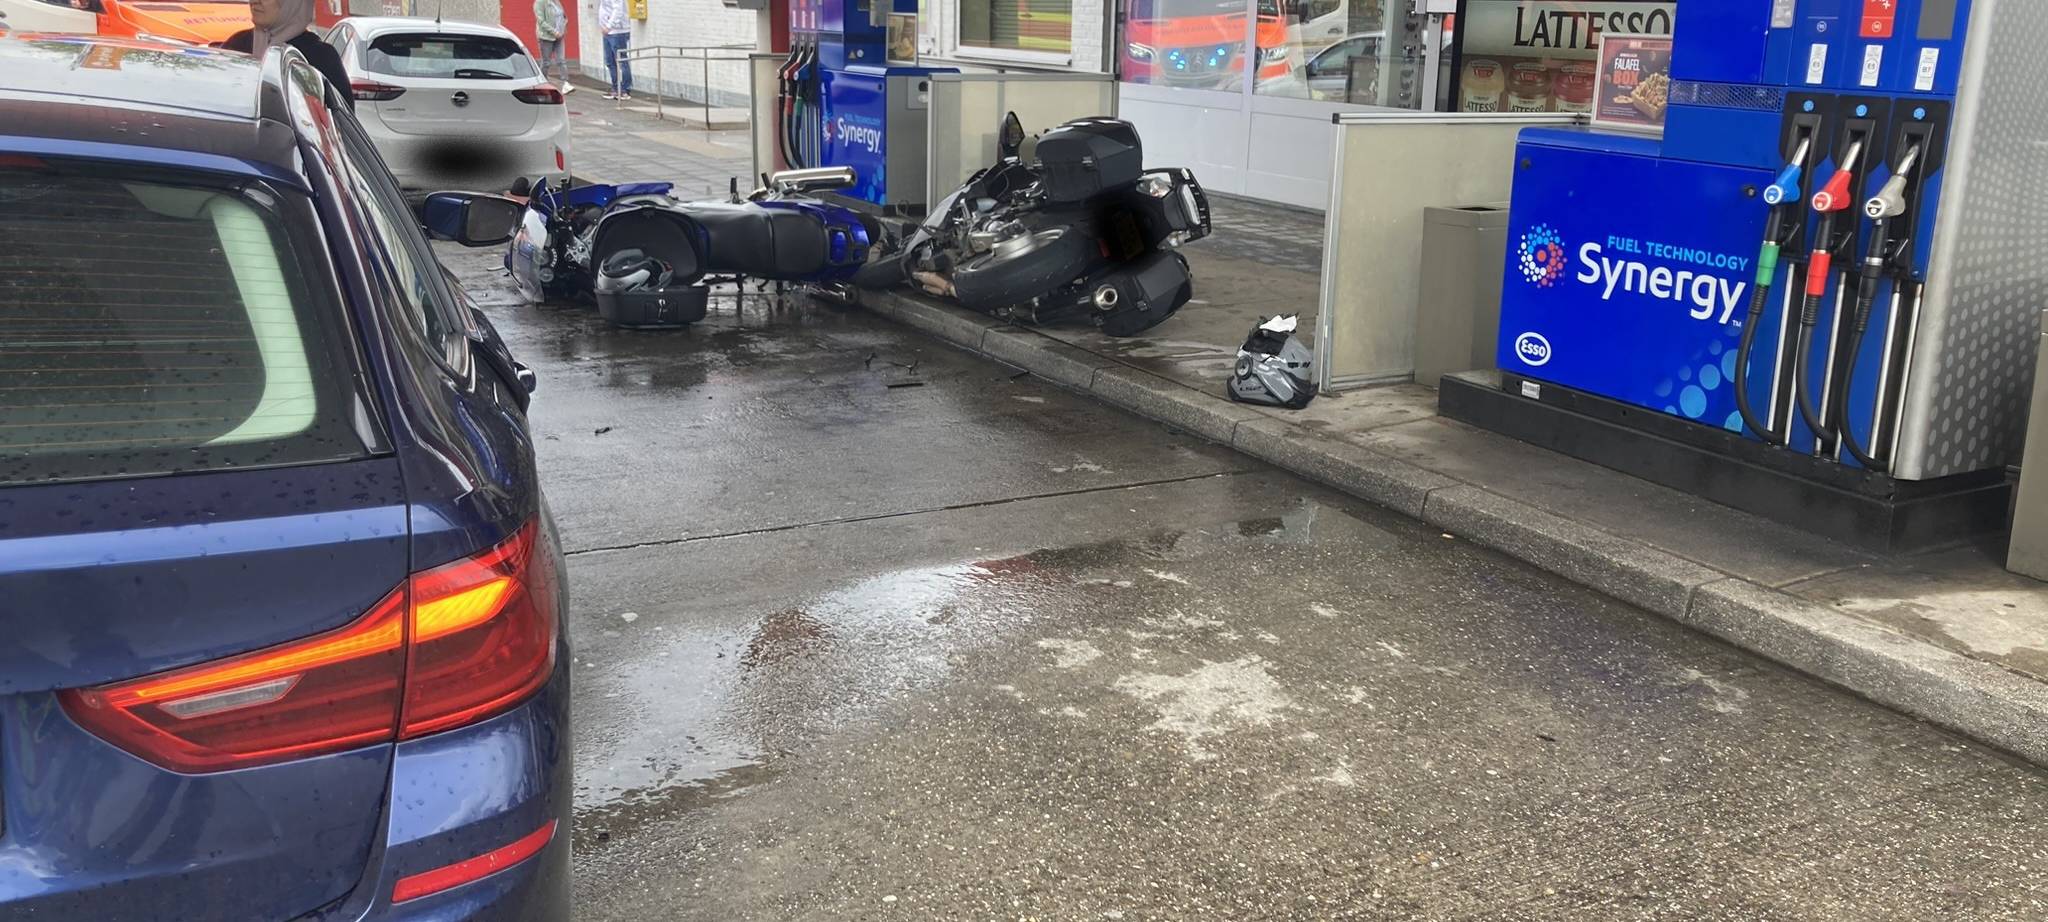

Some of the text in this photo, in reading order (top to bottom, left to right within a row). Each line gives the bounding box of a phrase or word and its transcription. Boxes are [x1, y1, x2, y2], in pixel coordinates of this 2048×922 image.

[1513, 7, 1671, 49] LATTESSO
[1613, 70, 1639, 86] BOX
[1615, 57, 1640, 71] FALAFEL
[837, 117, 881, 153] Synergy
[1607, 235, 1748, 271] FUEL TECHNOLOGY
[1577, 242, 1747, 325] Synergy
